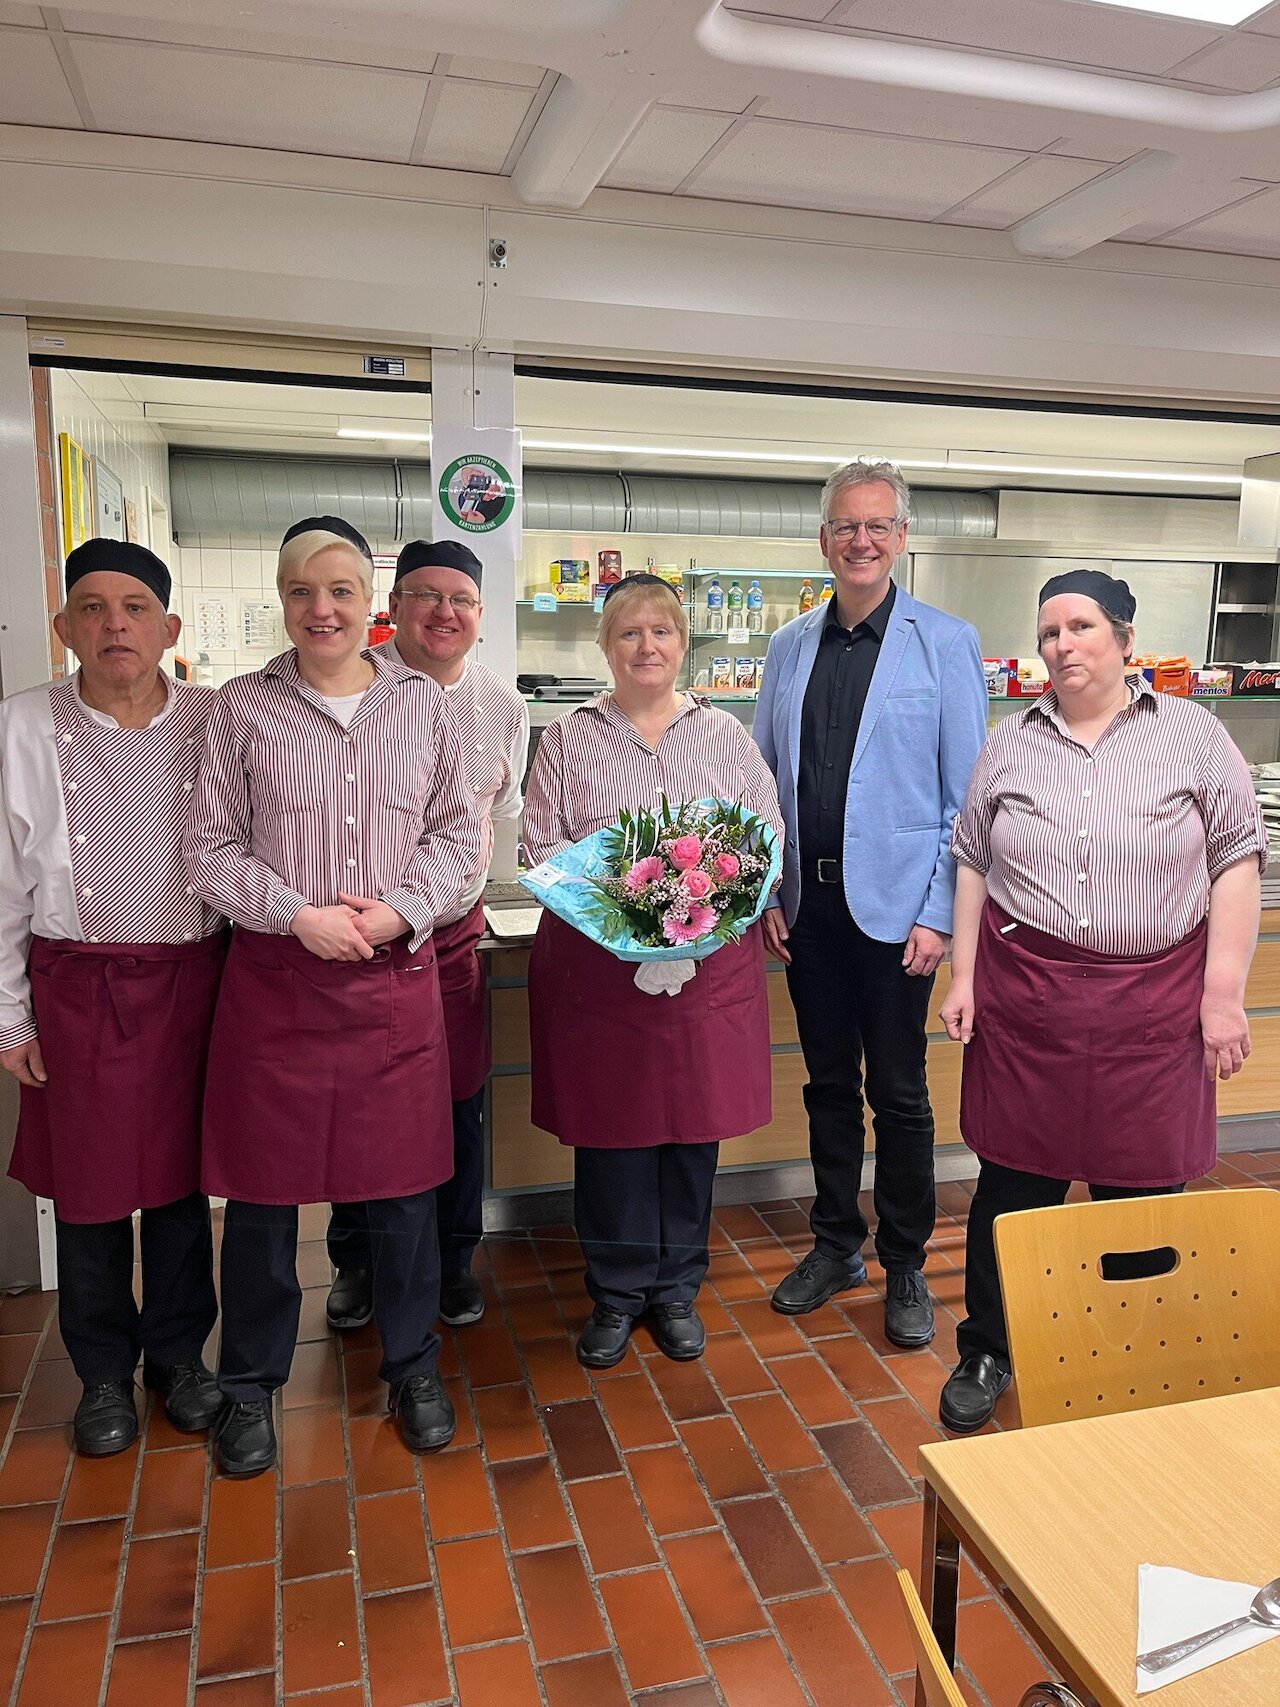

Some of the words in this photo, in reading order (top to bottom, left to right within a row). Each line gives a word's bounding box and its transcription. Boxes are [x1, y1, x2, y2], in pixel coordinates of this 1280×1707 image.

[457, 458, 466, 466] WIR
[467, 456, 496, 468] AKZEPTIEREN
[459, 520, 496, 531] KARTENZAHLUNG
[1239, 669, 1280, 690] Mar
[1022, 682, 1043, 691] hanuto
[1193, 687, 1228, 695] mentos
